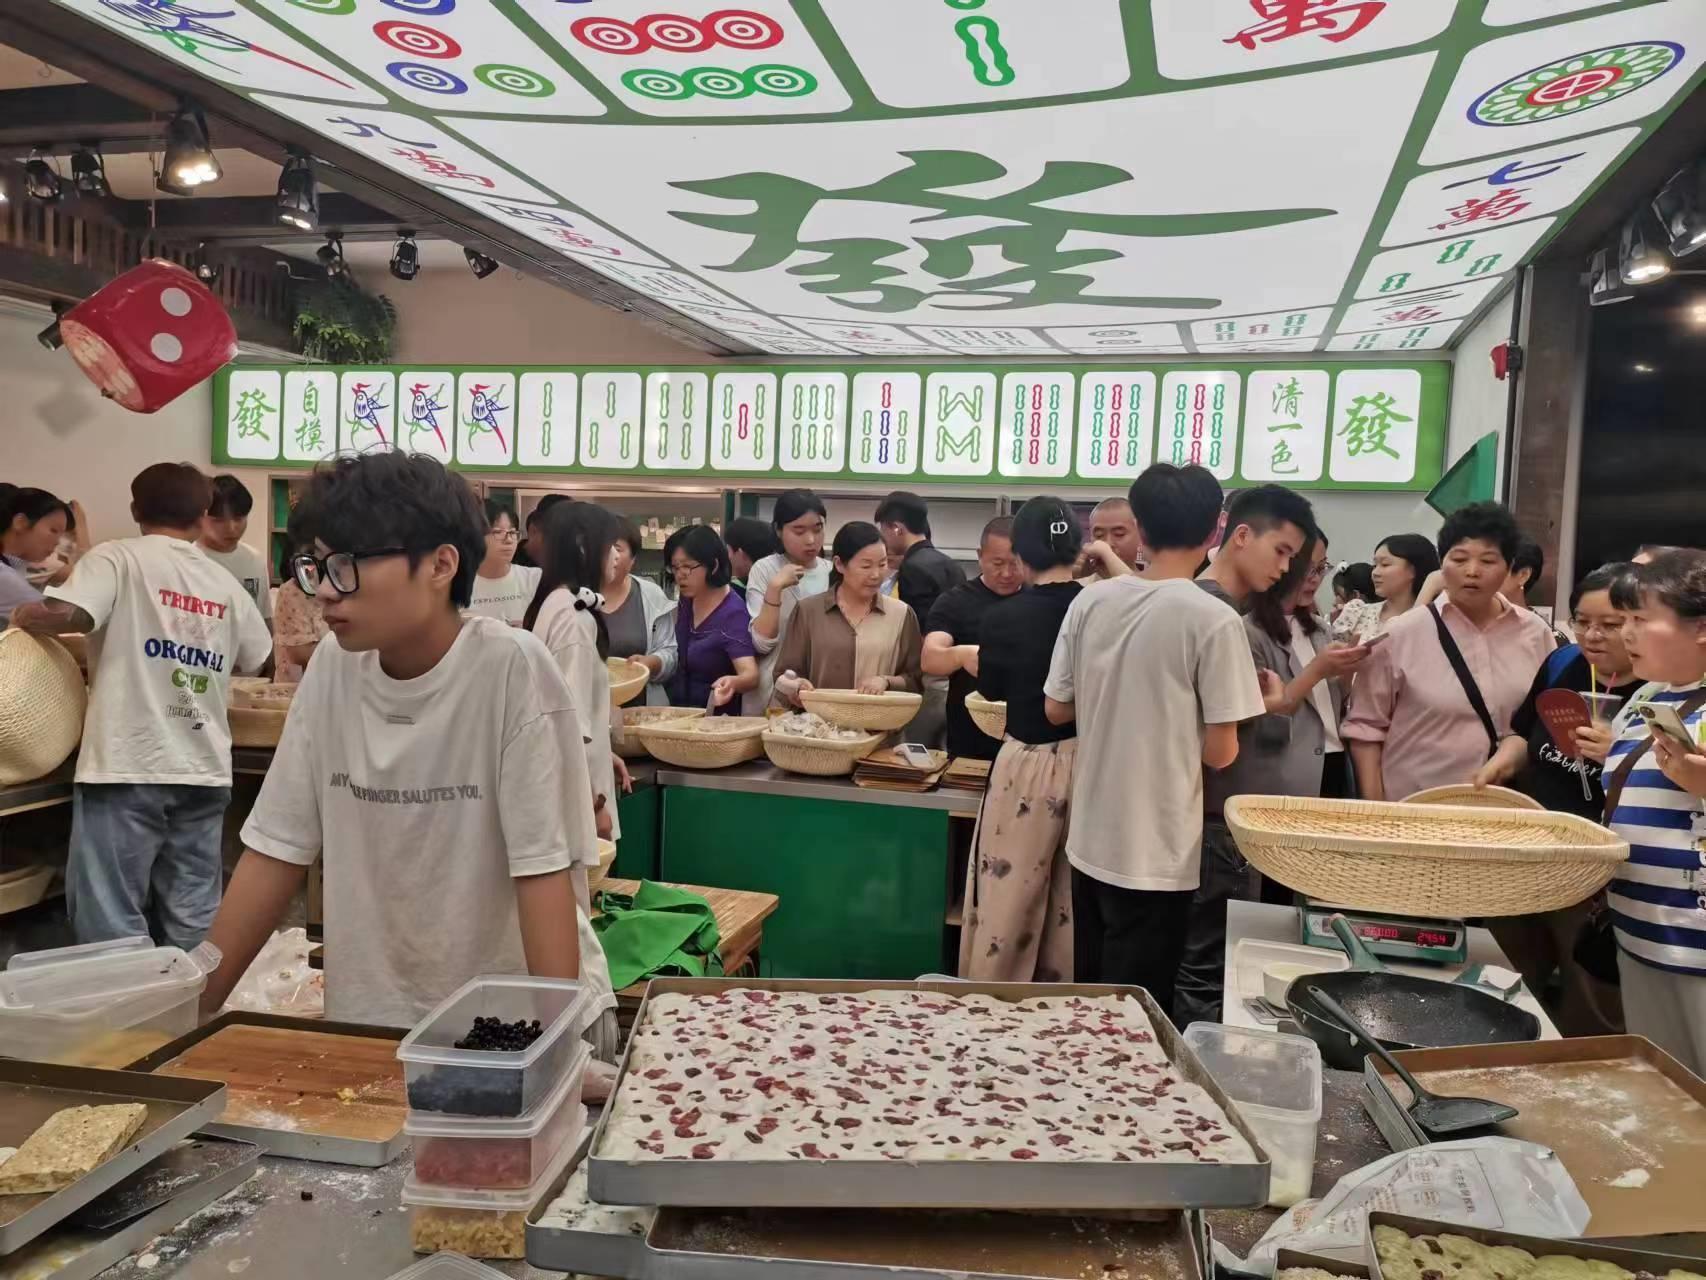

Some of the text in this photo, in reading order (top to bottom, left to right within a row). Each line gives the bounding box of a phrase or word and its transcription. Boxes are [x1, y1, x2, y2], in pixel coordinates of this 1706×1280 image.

[232, 388, 277, 441] 發
[295, 380, 325, 452] 自摸
[1267, 377, 1304, 474] 清一色
[1336, 392, 1413, 460] 發
[329, 772, 350, 787] MY
[402, 786, 455, 804] SALUTES
